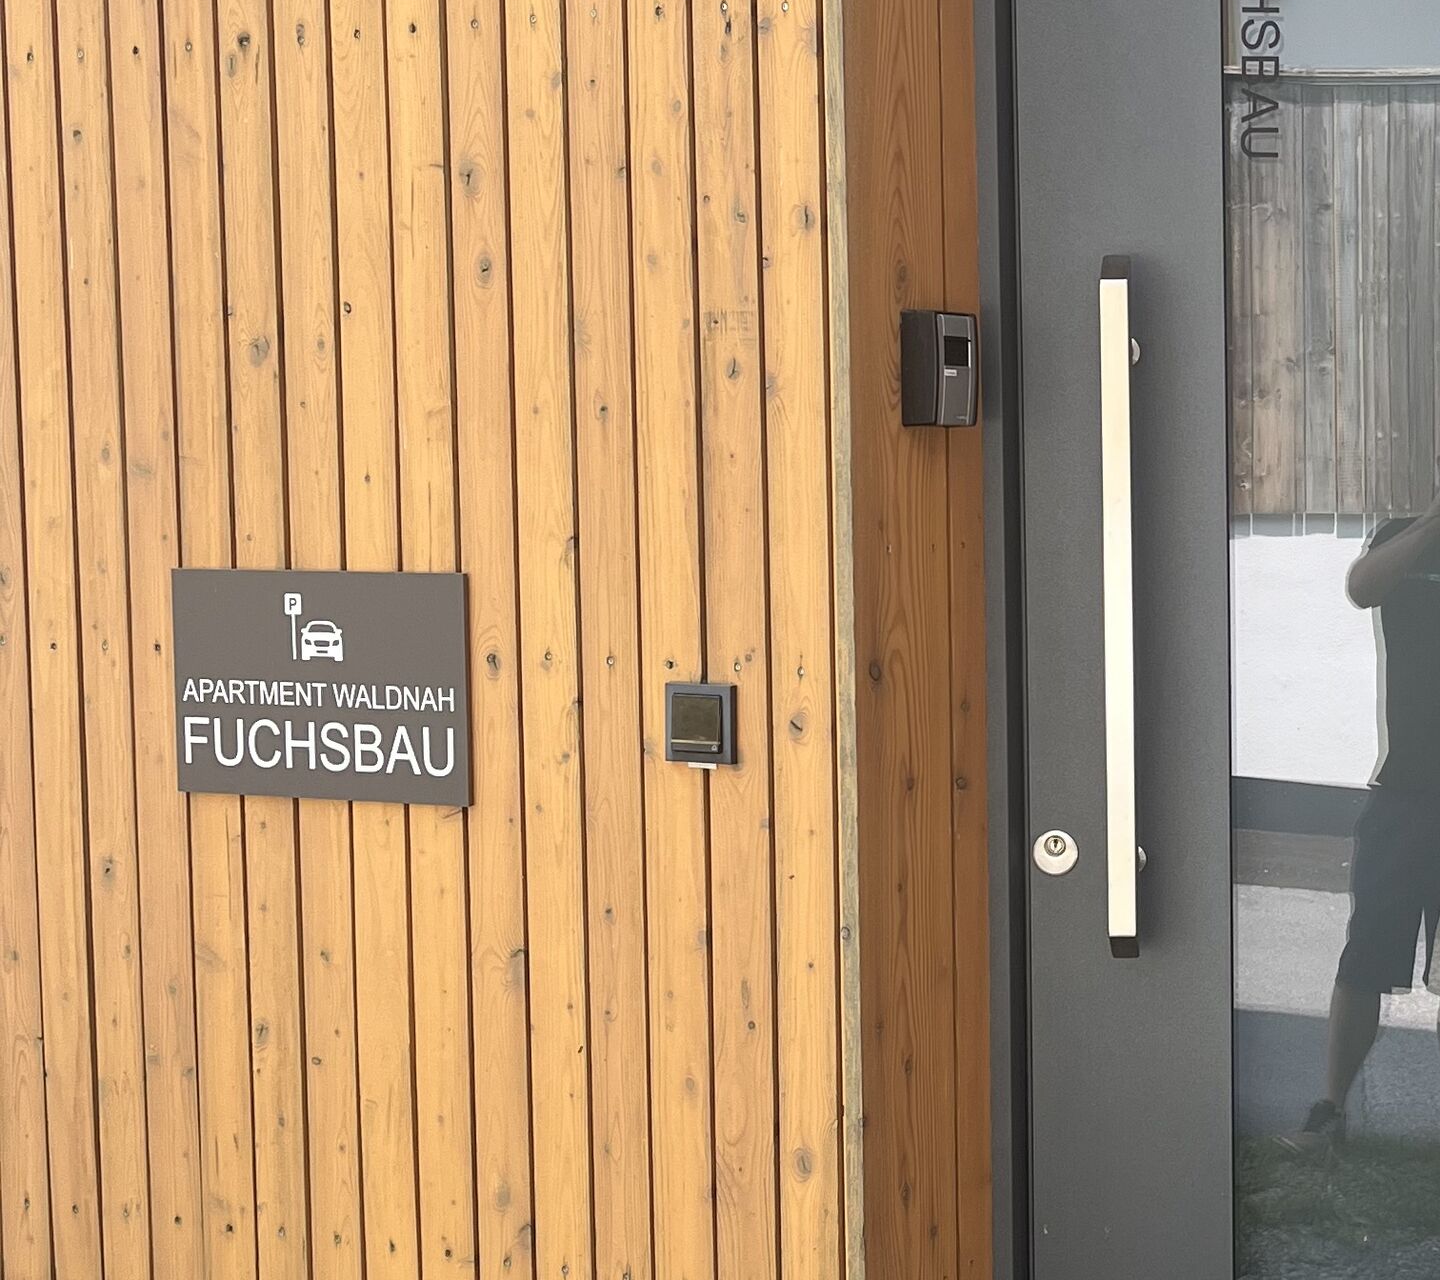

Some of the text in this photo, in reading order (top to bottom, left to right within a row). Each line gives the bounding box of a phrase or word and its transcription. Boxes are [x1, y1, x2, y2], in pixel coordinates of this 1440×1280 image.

[288, 597, 297, 611] P
[183, 678, 455, 712] APARTMENT WALDNAH
[184, 716, 455, 777] FUCHSBAU
